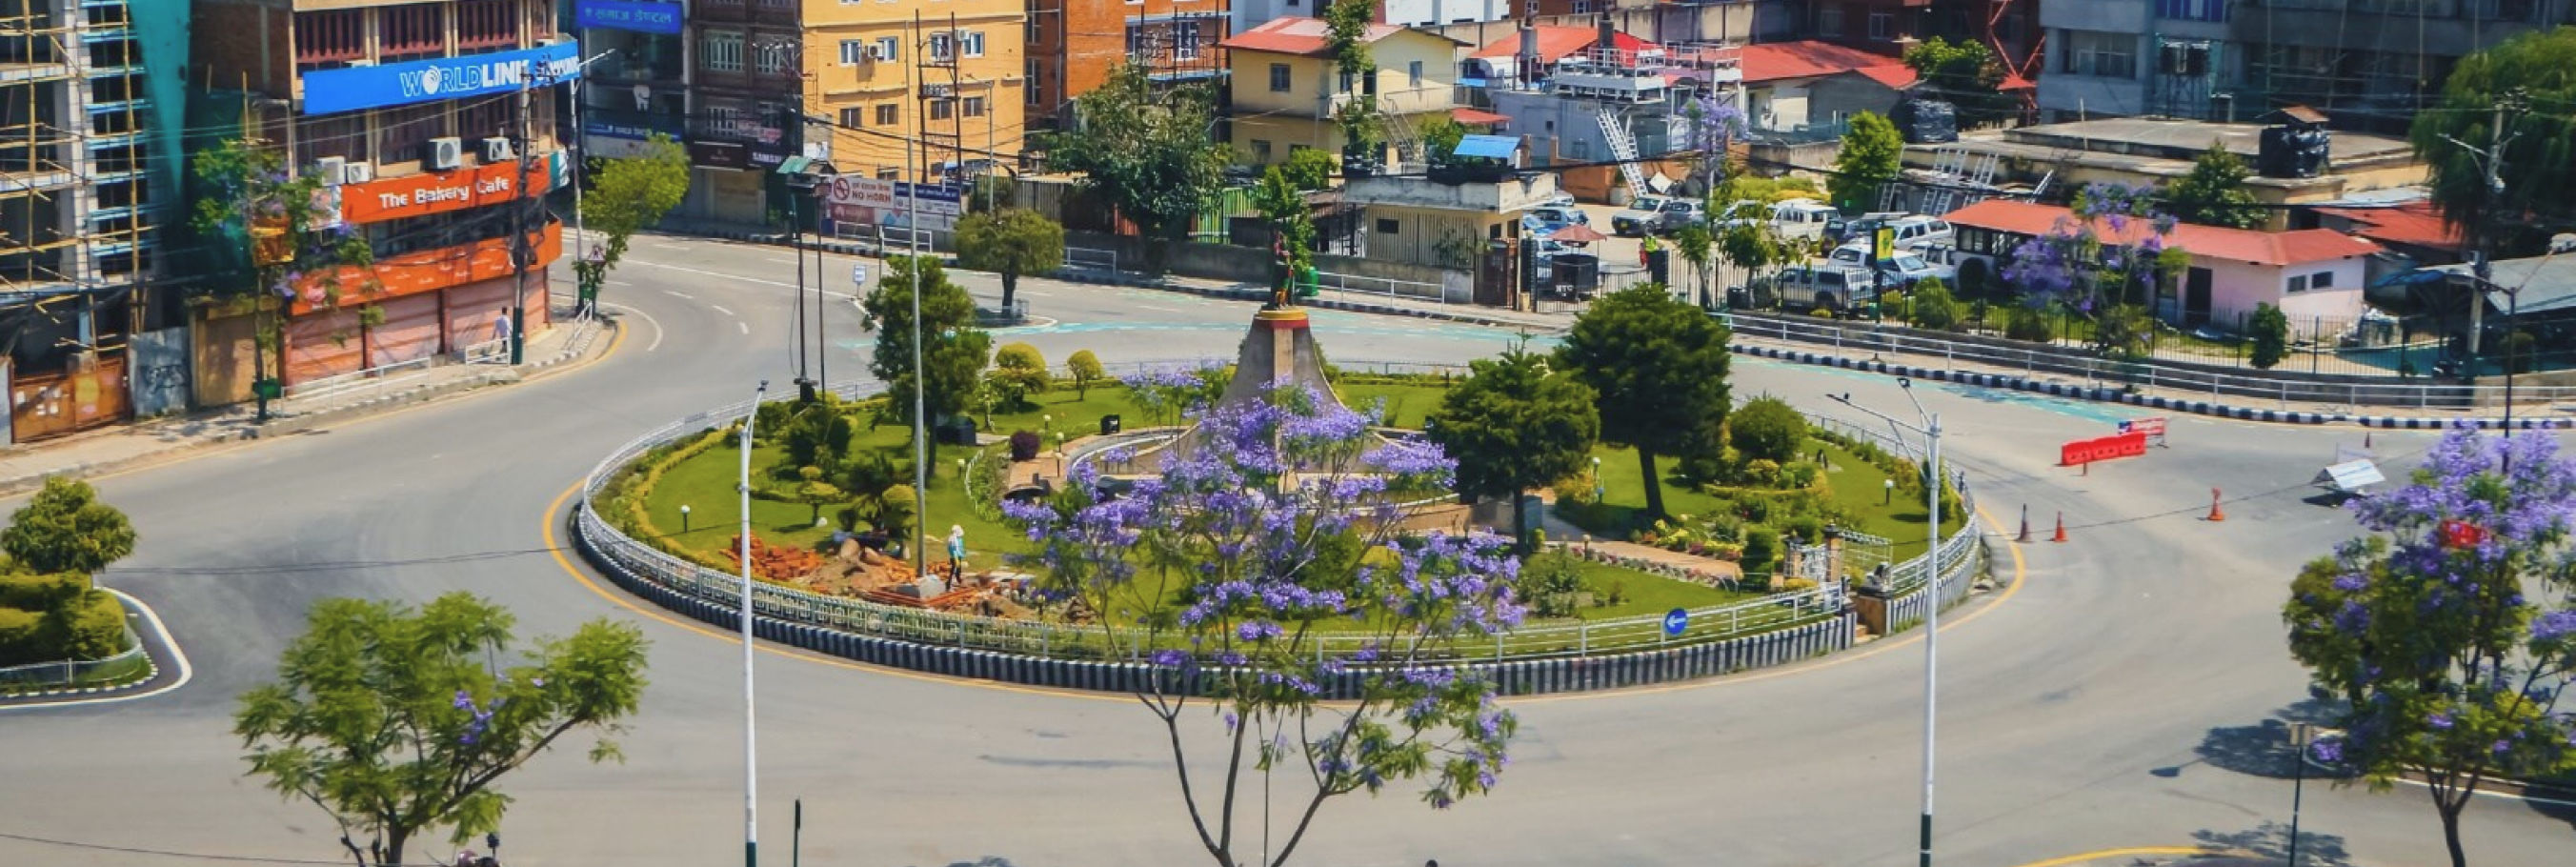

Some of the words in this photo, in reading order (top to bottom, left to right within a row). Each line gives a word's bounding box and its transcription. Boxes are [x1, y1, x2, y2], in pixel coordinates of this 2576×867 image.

[399, 60, 530, 97] WORLDLINK
[377, 192, 409, 209] The
[414, 185, 470, 205] Bakery
[475, 175, 510, 195] Cafe
[852, 190, 864, 200] NO
[866, 192, 892, 203] HORN
